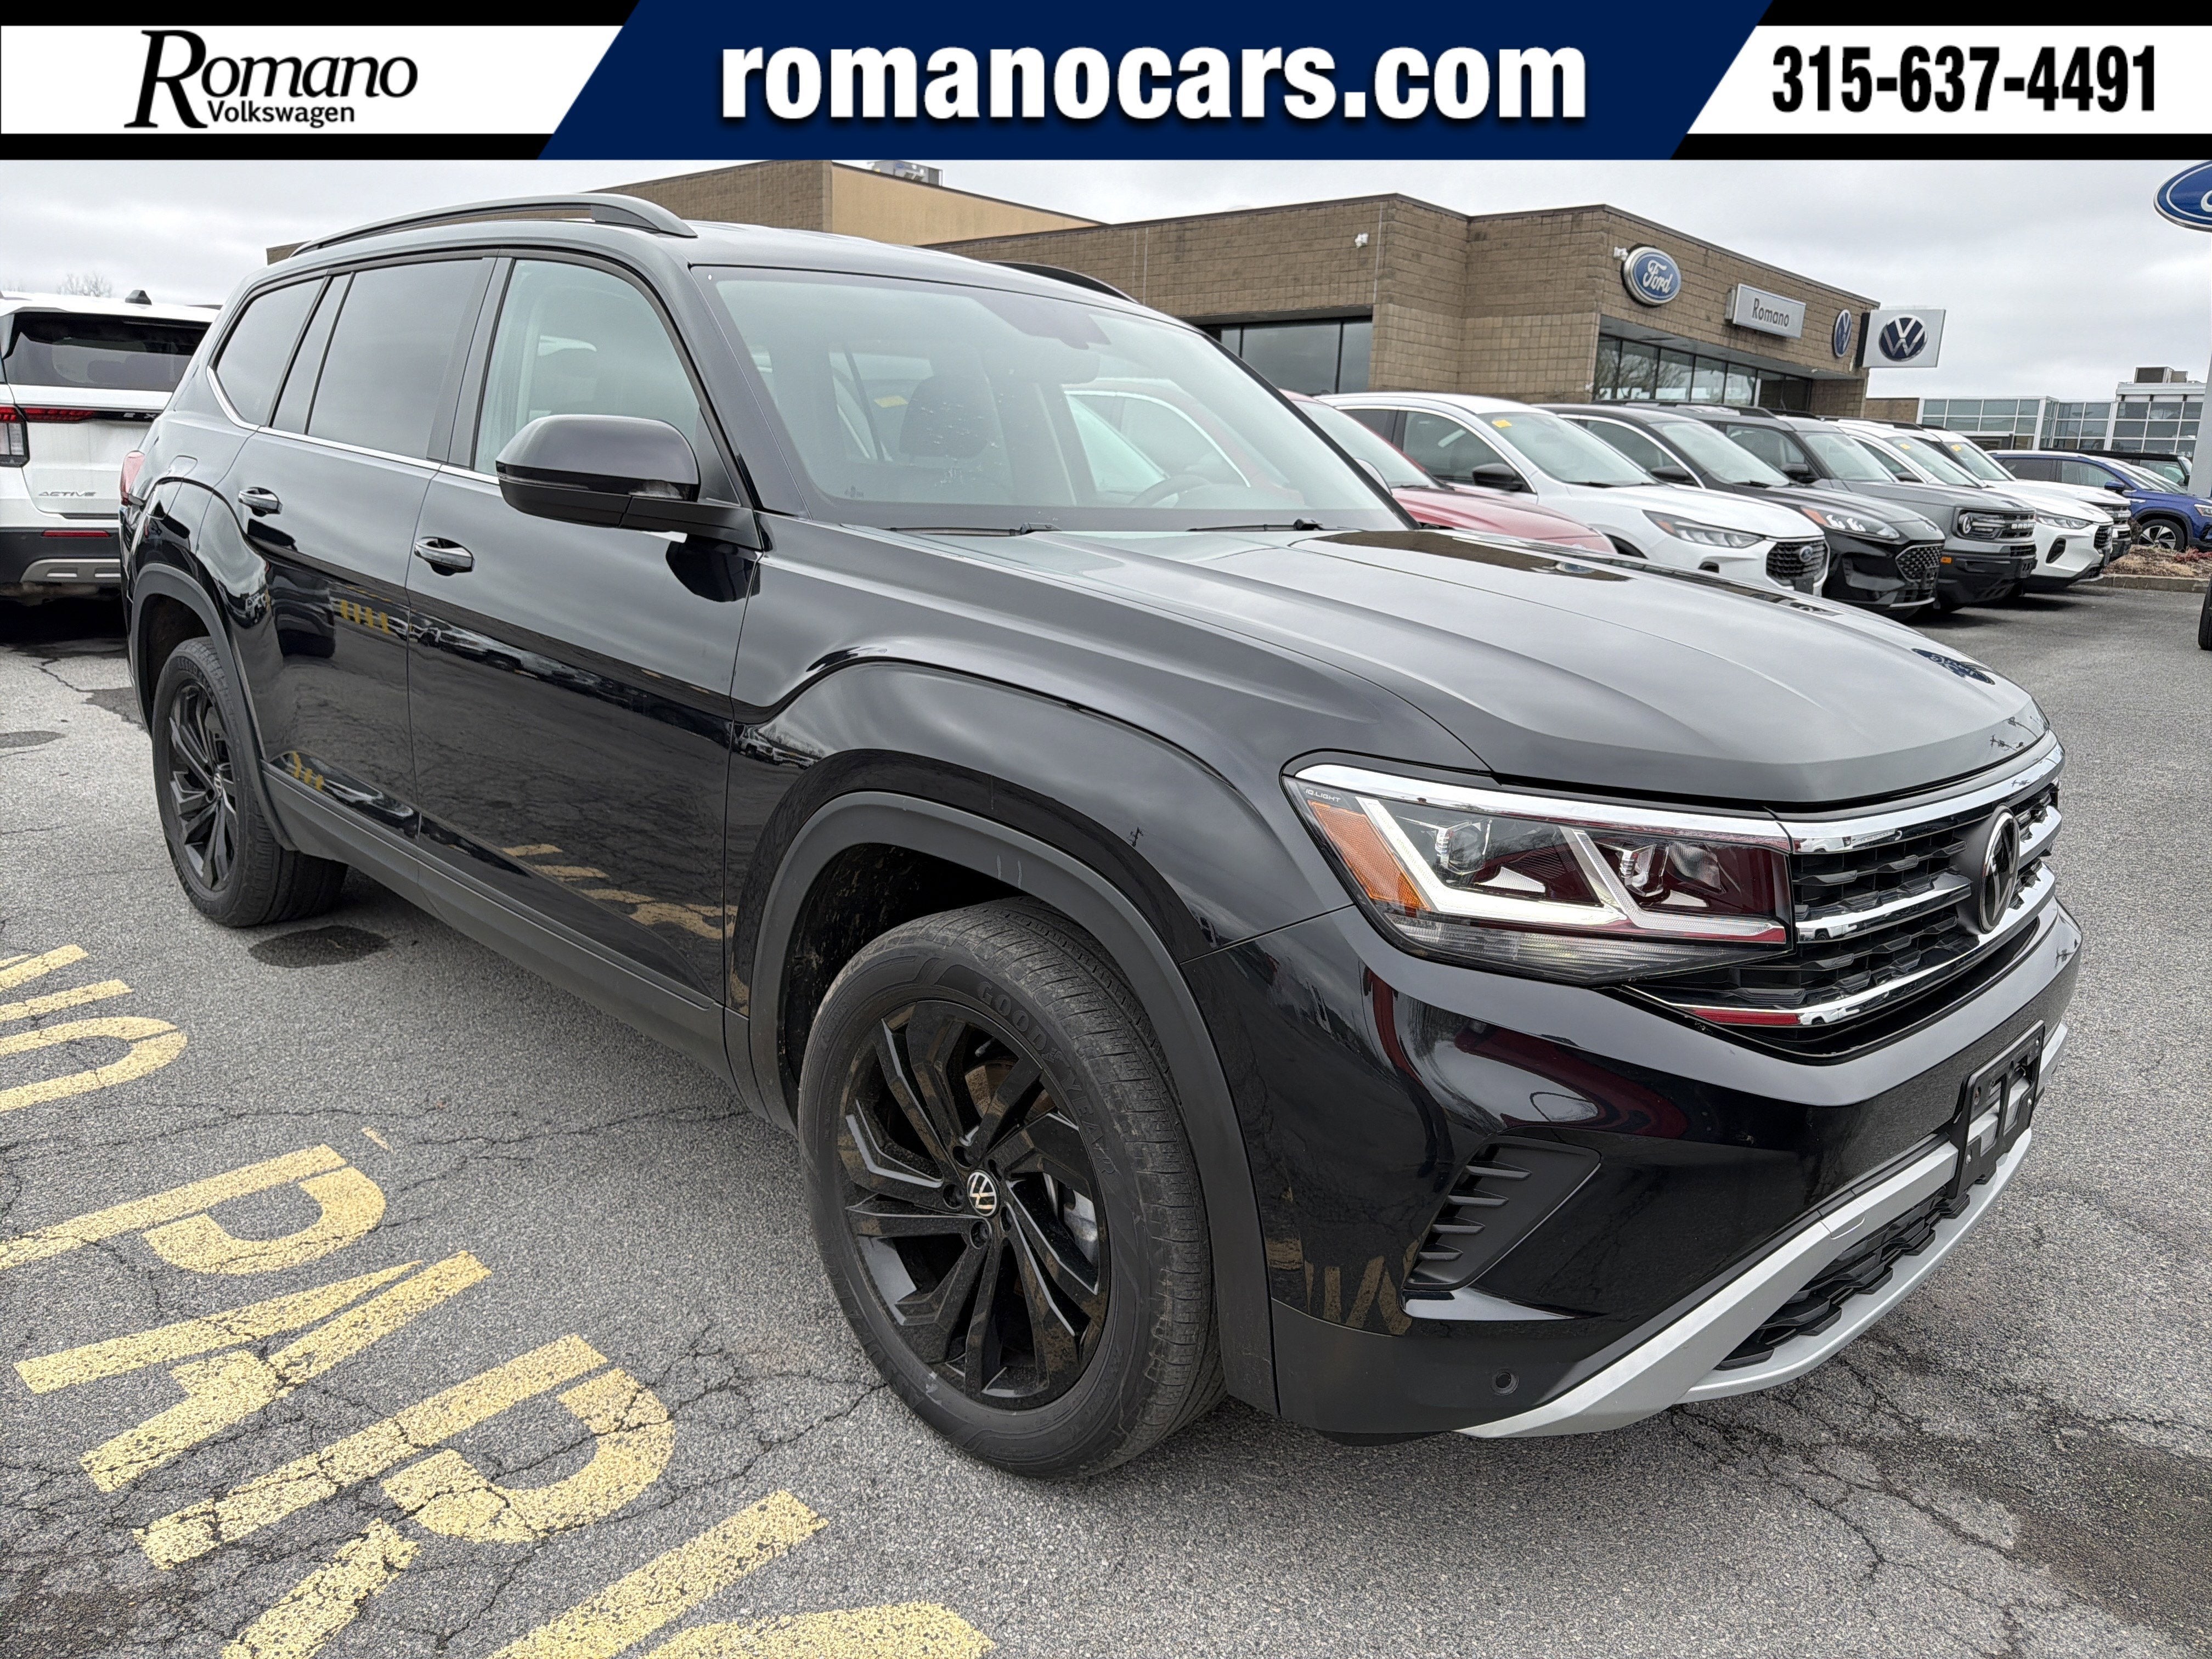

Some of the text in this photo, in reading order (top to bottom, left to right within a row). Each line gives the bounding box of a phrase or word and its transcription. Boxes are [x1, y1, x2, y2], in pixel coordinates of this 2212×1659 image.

[1642, 259, 1673, 295] Ford
[1752, 297, 1790, 328] Romano
[977, 980, 1118, 1175] GOODYEAR
